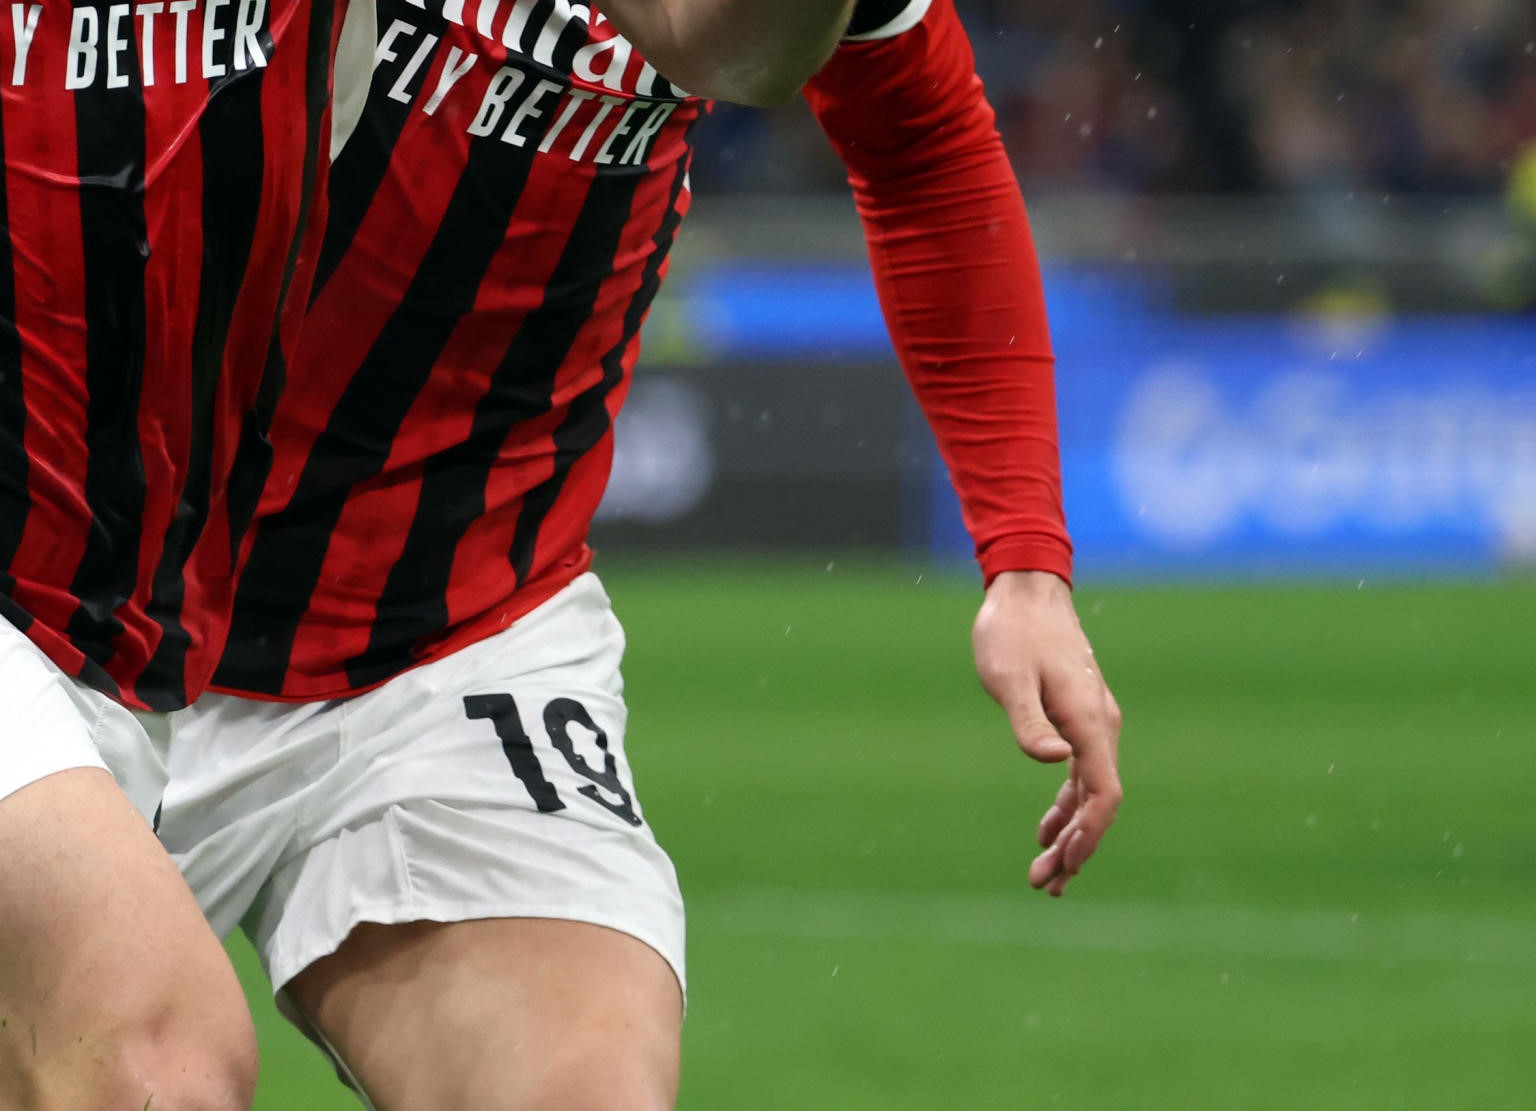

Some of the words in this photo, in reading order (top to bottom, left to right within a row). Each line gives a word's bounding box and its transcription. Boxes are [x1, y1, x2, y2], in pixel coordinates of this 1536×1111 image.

[373, 18, 478, 116] FLY
[466, 66, 678, 166] BETTER
[463, 693, 642, 827] 19
